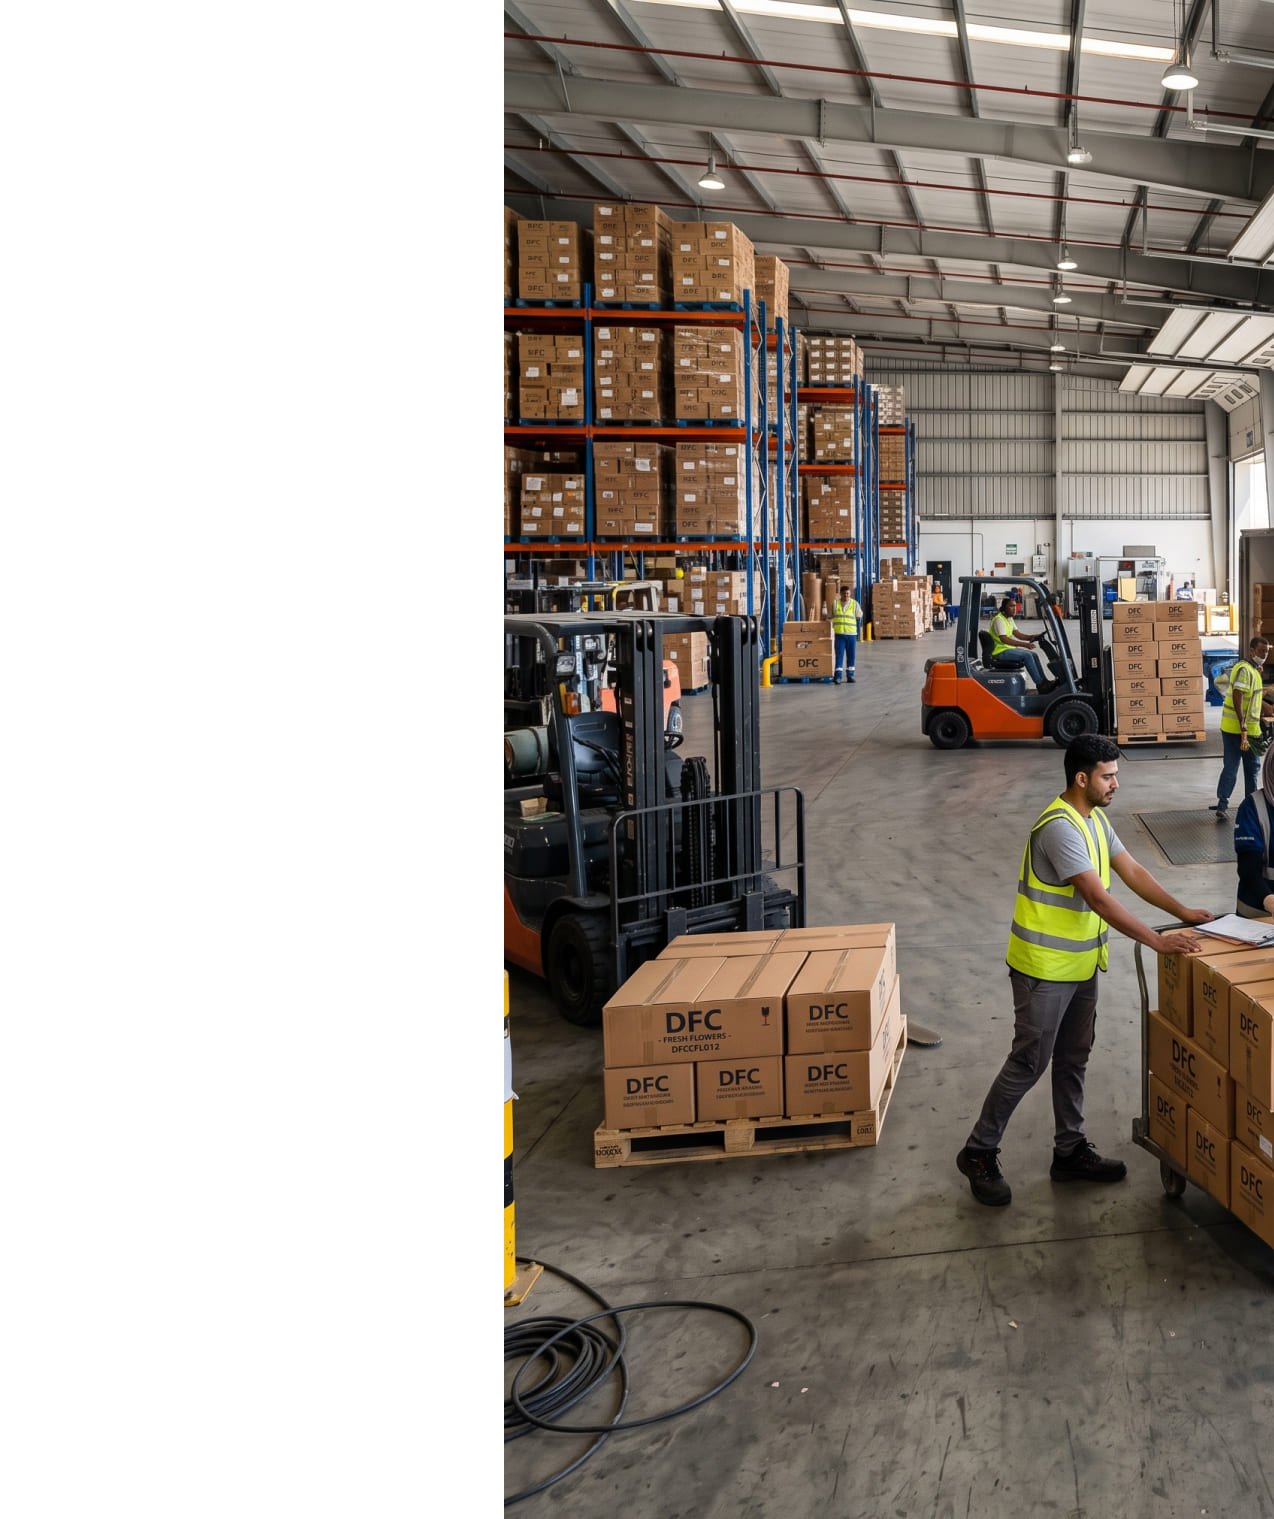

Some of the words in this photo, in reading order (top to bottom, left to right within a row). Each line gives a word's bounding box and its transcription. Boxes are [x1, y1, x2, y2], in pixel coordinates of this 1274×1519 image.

[798, 658, 818, 668] DFC
[1202, 982, 1216, 1004] DFC
[666, 1009, 722, 1033] DFC
[809, 1003, 848, 1020] DFC
[663, 1035, 687, 1043] FRESH
[689, 1033, 726, 1042] FLOWERS
[1240, 1013, 1258, 1042] DFC
[671, 1043, 720, 1053] DFCCFL012
[1172, 1039, 1196, 1078] DFC
[719, 1068, 760, 1086] DFC
[807, 1064, 848, 1081] DFC
[626, 1075, 669, 1094] DFC
[1157, 1095, 1175, 1124] DFC
[1246, 1101, 1262, 1126] DFC
[1196, 1131, 1215, 1162] DFC
[1241, 1166, 1263, 1199] DFC
